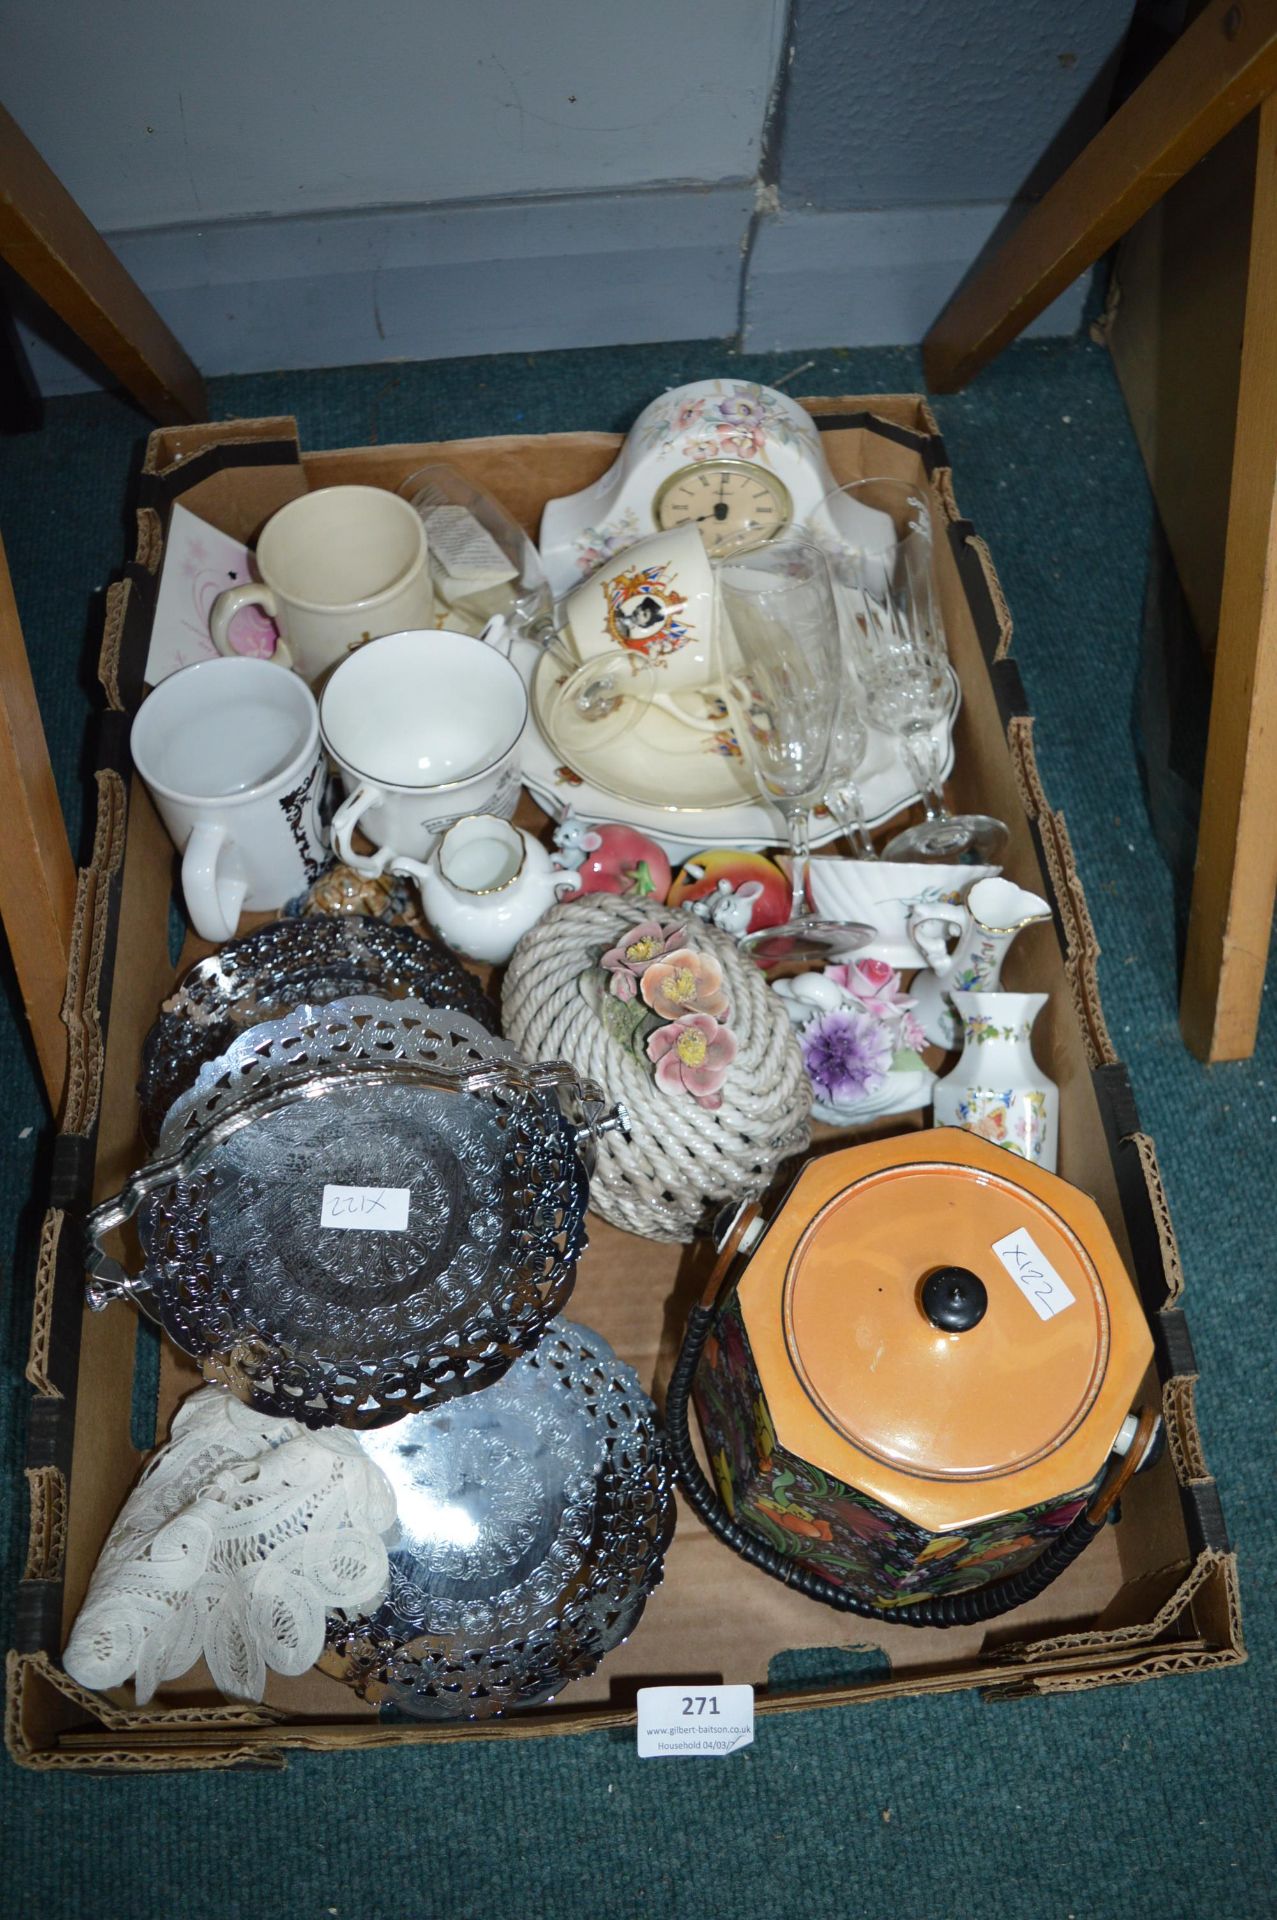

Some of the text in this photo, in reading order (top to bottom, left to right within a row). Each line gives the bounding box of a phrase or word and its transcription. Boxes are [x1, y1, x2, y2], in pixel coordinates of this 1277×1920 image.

[682, 1696, 721, 1716] 271
[646, 1725, 752, 1736] www.gilbert-baitson.co.uk
[658, 1741, 701, 1750] Household
